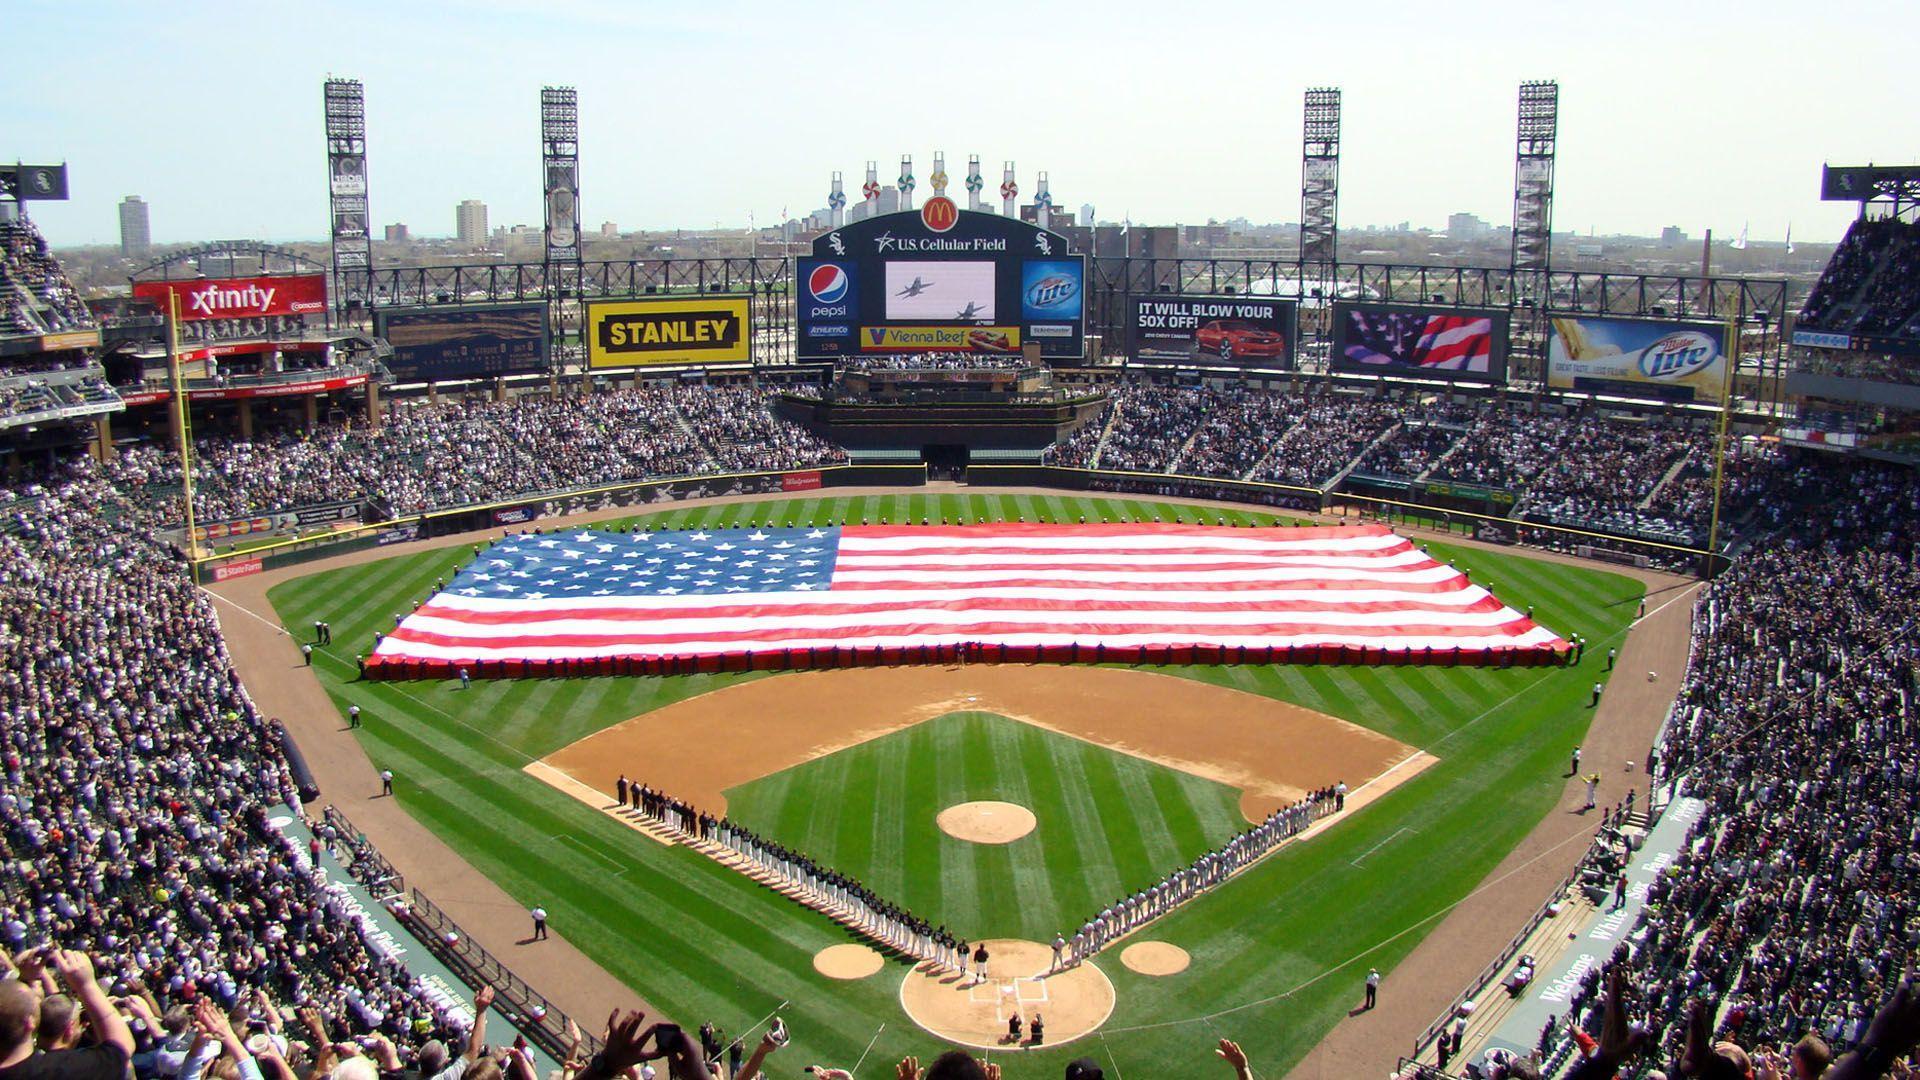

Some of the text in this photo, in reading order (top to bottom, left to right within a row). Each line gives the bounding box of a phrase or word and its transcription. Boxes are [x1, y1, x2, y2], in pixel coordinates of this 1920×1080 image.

[920, 238, 972, 251] Cellular
[974, 238, 1007, 251] Field
[192, 284, 276, 315] xfinity
[812, 305, 846, 318] pepsi
[1138, 302, 1273, 319] IT WILL BLOW YOUR
[1138, 315, 1198, 329] SOX OFF!
[610, 319, 729, 346] STANLEY
[891, 329, 966, 346] Vienna Beef
[1663, 337, 1697, 351] Miller
[1649, 346, 1707, 378] Lite
[1539, 952, 1595, 1003] Welcome
[1589, 909, 1629, 941] White
